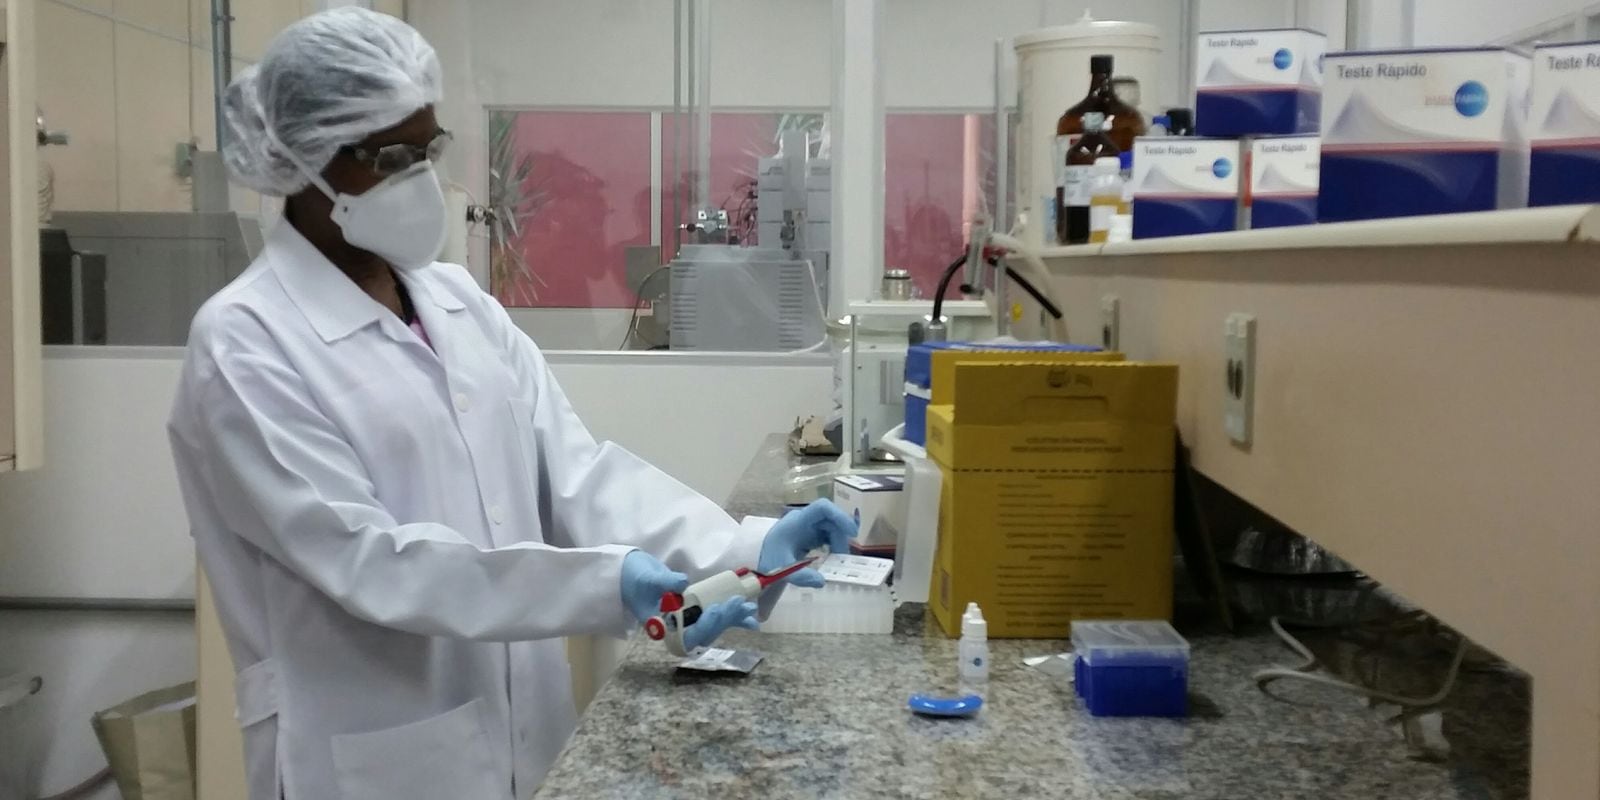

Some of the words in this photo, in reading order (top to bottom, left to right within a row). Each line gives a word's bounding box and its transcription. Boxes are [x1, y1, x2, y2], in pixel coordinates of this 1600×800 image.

[1208, 38, 1229, 48] Teste
[1548, 55, 1583, 70] Teste
[1337, 64, 1373, 79] Teste
[1377, 62, 1427, 81] Rápido
[1145, 146, 1166, 155] Teste
